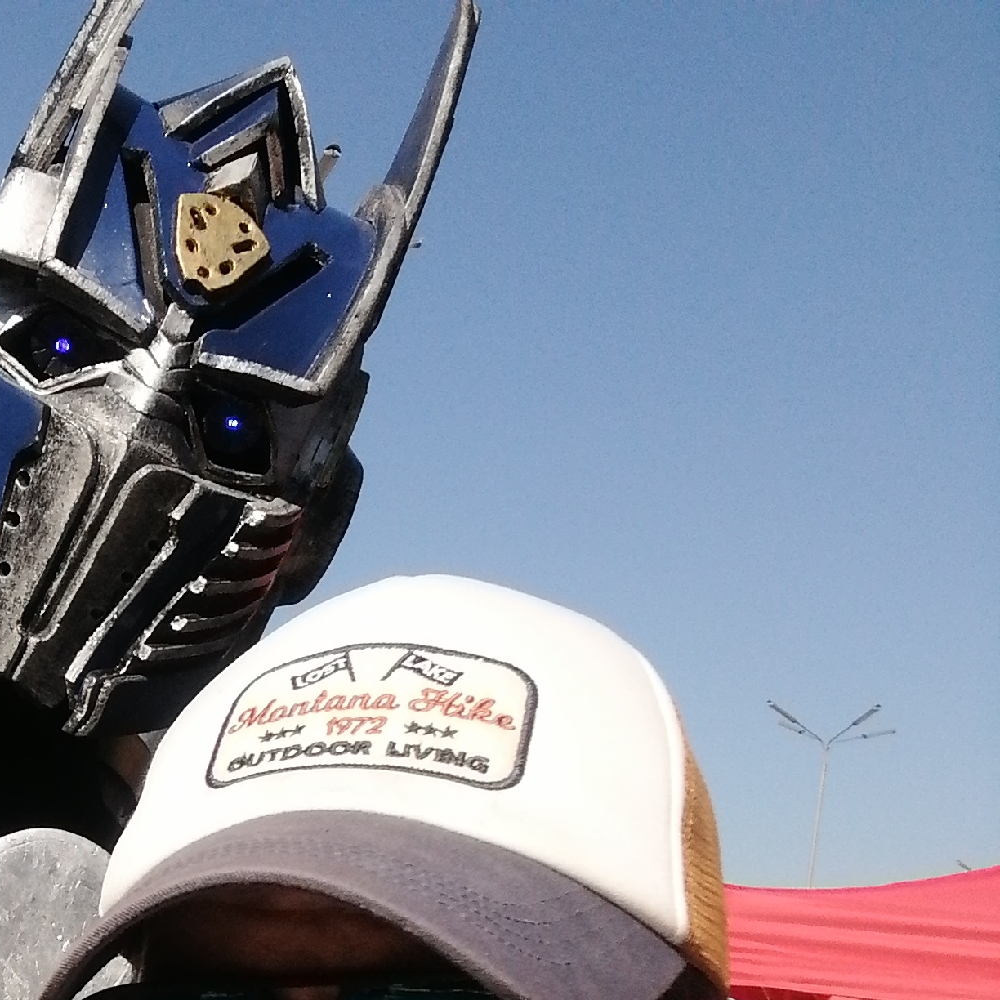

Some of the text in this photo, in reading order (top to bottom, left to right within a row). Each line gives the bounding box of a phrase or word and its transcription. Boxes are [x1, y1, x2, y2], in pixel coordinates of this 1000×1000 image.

[296, 655, 457, 688] LOST LAKE
[228, 688, 517, 734] Montana Hike
[326, 716, 388, 735] 1972
[227, 741, 490, 774] OUTDOOR LIVING
